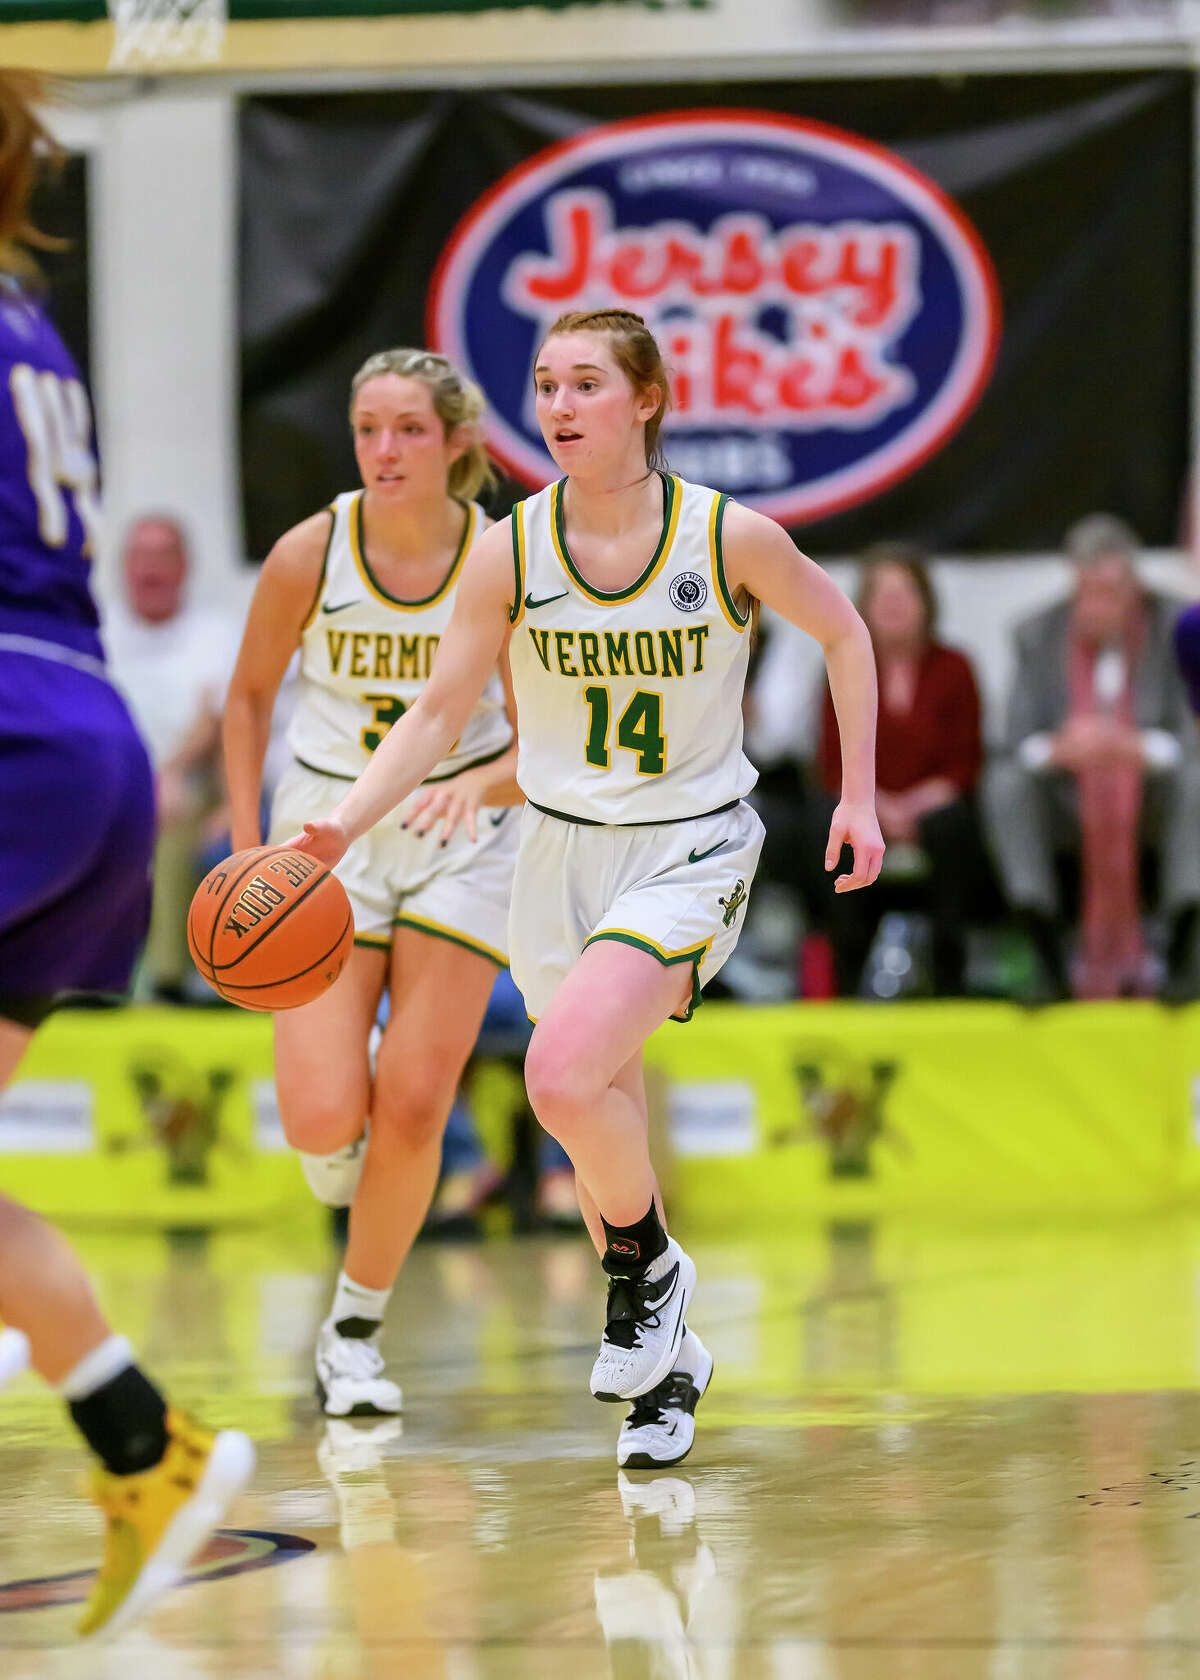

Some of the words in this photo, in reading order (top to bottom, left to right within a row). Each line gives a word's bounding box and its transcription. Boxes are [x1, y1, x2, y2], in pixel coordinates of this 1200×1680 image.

[520, 202, 904, 329] Jersey
[670, 314, 882, 415] ike's
[326, 630, 441, 680] VERMO
[528, 624, 710, 678] VERMONT
[582, 684, 668, 777] 14
[269, 854, 319, 889] THE
[223, 875, 287, 940] ROCK
